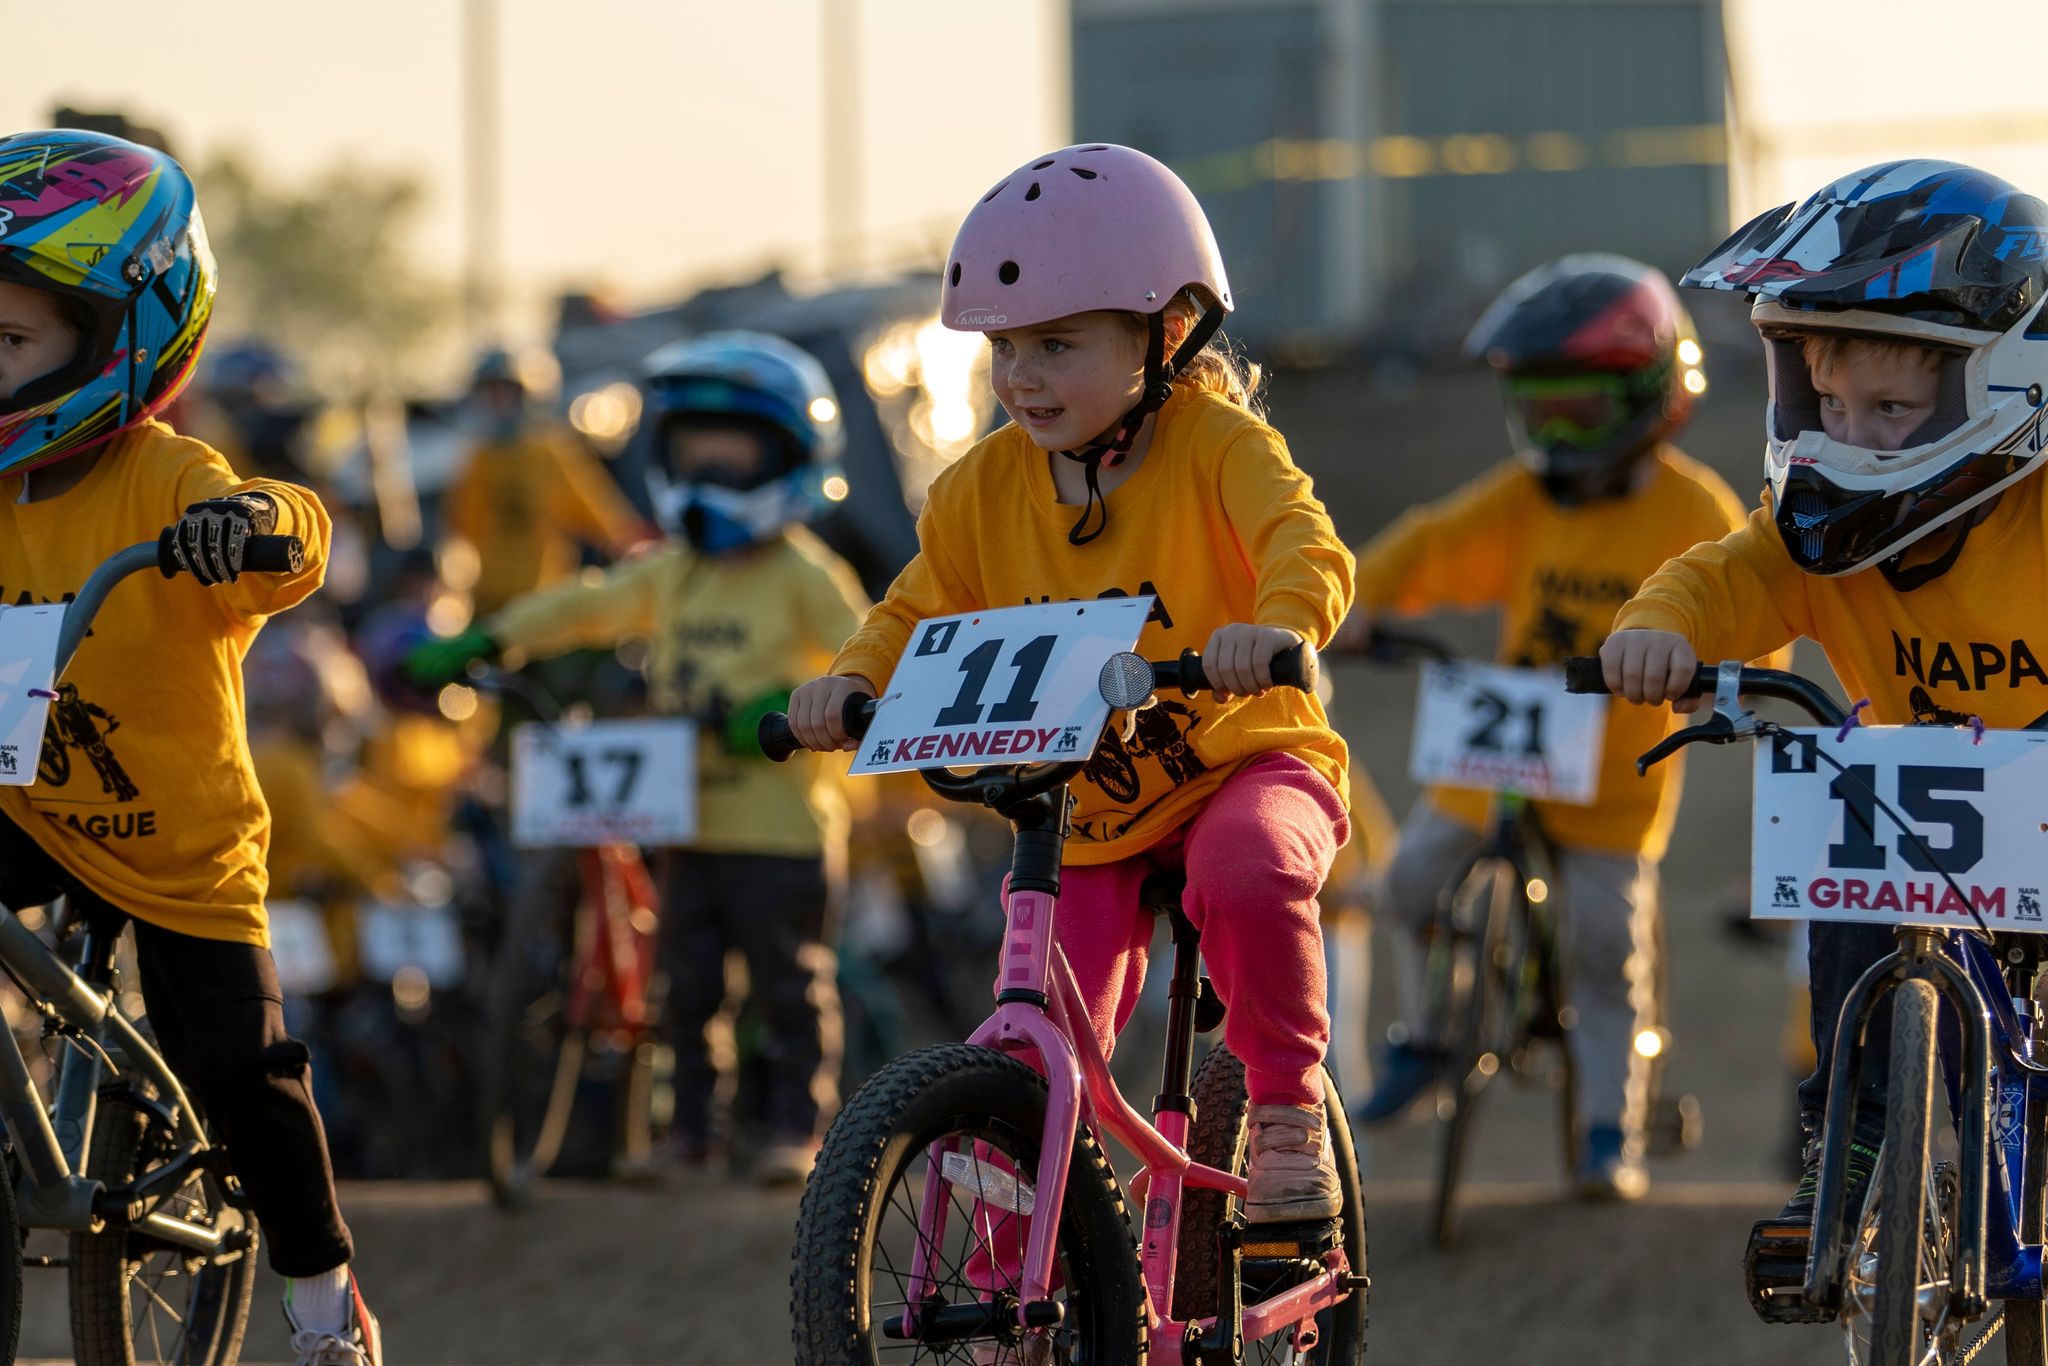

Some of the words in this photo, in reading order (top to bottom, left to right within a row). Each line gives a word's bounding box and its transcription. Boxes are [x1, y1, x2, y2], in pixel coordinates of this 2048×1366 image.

[959, 314, 1008, 325] AMUGO
[931, 625, 950, 653] 1
[1891, 628, 2048, 691] NAPA
[933, 634, 1058, 727] 11
[1468, 688, 1545, 755] 21
[892, 727, 1061, 763] KENNEDY
[564, 751, 644, 804] 17
[1829, 764, 1985, 874] 15
[1776, 875, 1798, 883] NAPA
[1808, 877, 2006, 918] GRAHAM
[2018, 887, 2040, 895] NAPA
